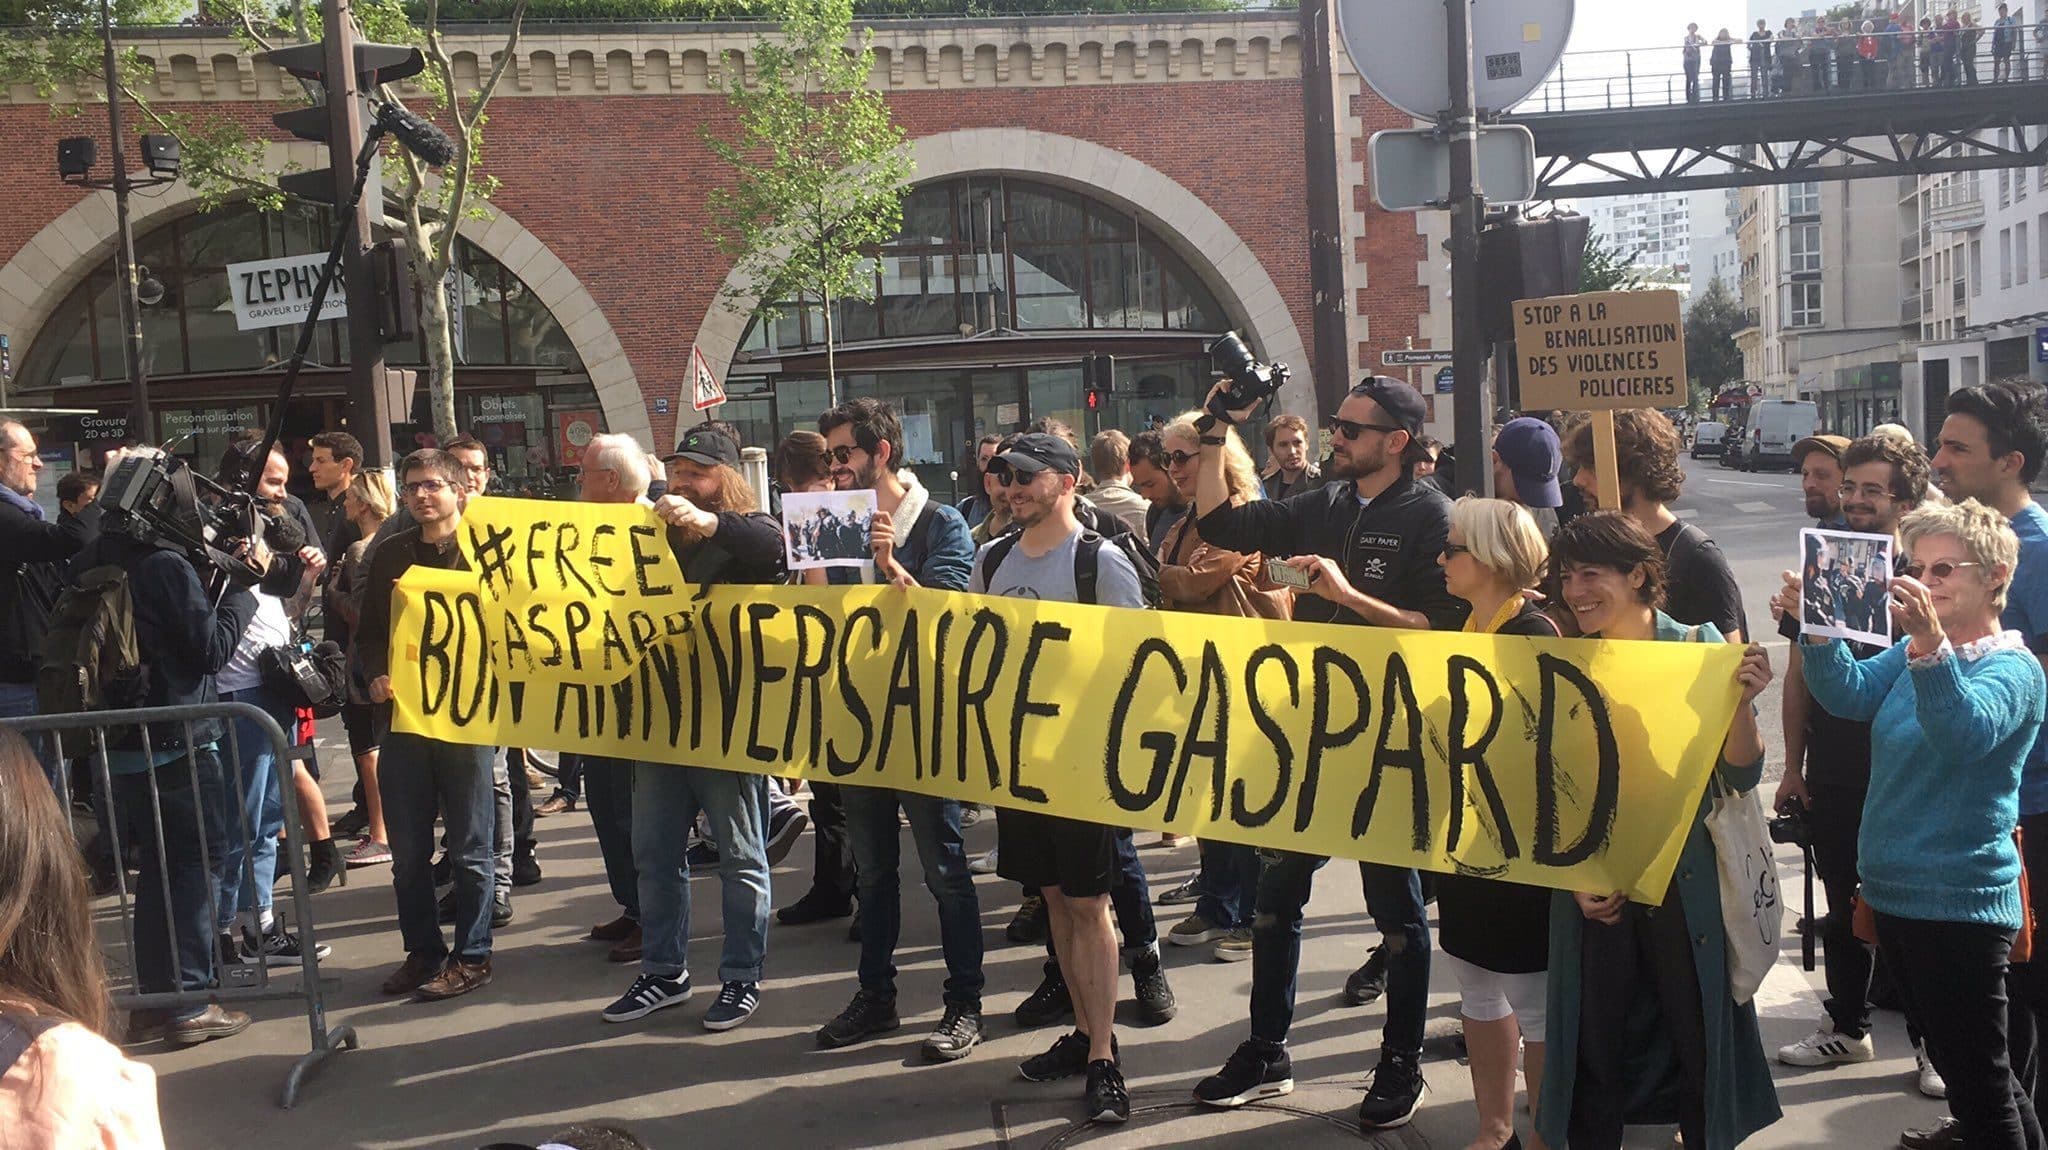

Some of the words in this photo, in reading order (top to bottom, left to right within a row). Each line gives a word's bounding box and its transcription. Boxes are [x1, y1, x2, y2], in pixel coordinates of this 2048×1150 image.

[241, 261, 346, 305] ZEPHYR
[249, 306, 291, 318] GRAVEUR
[1524, 304, 1562, 325] STOP
[1570, 303, 1581, 322] A
[1588, 302, 1607, 321] LA
[1545, 323, 1676, 348] BENALLISATION
[1529, 356, 1558, 376] DES
[1580, 376, 1674, 398] POLICIERES
[481, 398, 517, 412] Objets
[80, 415, 128, 428] Gravure
[165, 411, 254, 424] Personnalisation
[84, 428, 99, 438] 2D
[101, 429, 109, 438] et
[111, 428, 125, 438] 3D
[206, 425, 220, 434] sur
[222, 423, 246, 435] place
[1377, 537, 1399, 546] PAPER
[469, 520, 674, 600] #FREE
[1106, 637, 1622, 866] GASPARD
